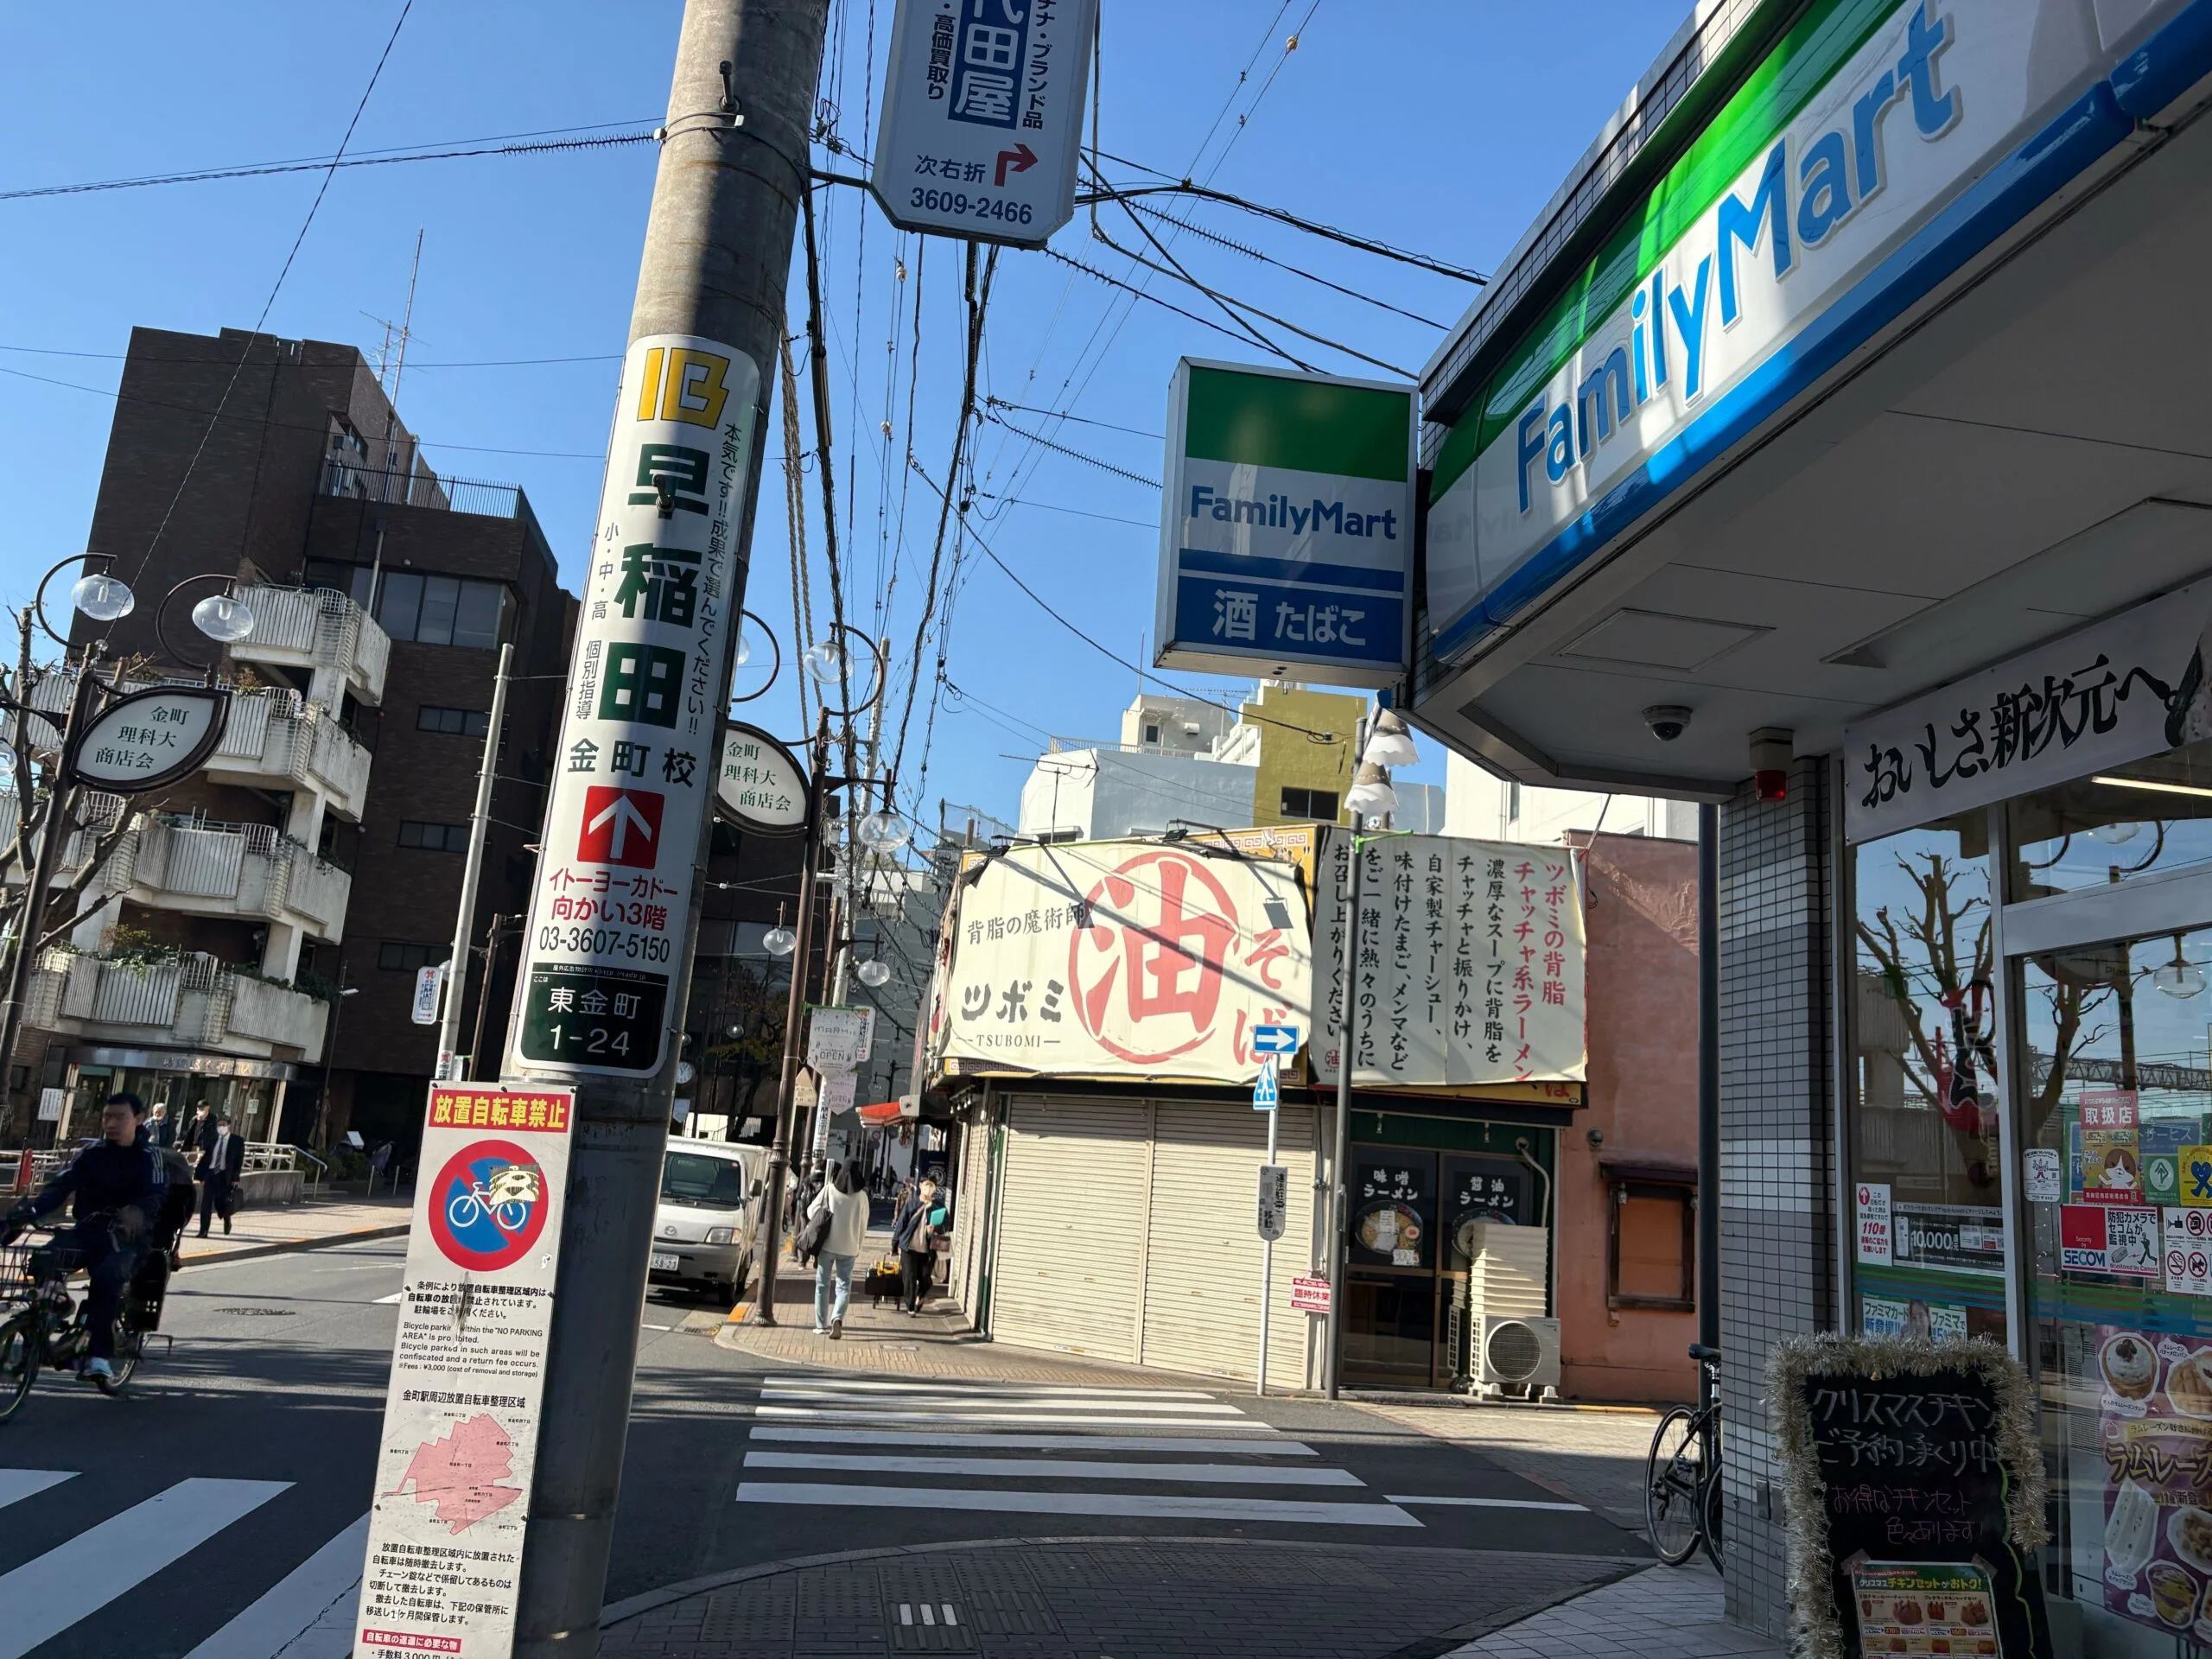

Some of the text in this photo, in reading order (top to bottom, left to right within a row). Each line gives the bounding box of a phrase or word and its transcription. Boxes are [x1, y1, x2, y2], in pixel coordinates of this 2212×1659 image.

[914, 154, 986, 184] 次右折
[910, 187, 1033, 225] 3609-2466
[1517, 0, 1957, 515] FamilyMart
[1191, 485, 1397, 540] FamilyMart
[597, 442, 710, 729] 早稲田
[1211, 588, 1366, 646] 酒 たばこ
[575, 639, 602, 721] 個別指導
[149, 705, 191, 726] 金町
[117, 725, 177, 748] 理科大
[1861, 653, 2171, 809] おいしさ新次元へ
[94, 746, 156, 770] 商店会
[726, 741, 761, 761] 金町
[567, 738, 697, 789] 金町校
[723, 763, 779, 786] 理科大
[740, 789, 791, 812] 商店会
[550, 868, 678, 900] イトーヨーカドー
[551, 895, 668, 931] 向かい3階
[967, 902, 1085, 945] 背脂の魔術師
[539, 926, 671, 963] 03-3607-5150
[1424, 854, 1445, 1036] 自家製チャーシュー、
[1540, 863, 1567, 1007] ツボミの背脂
[1086, 859, 1237, 1038] 油
[1357, 846, 1383, 1068] をご一緒に熱々のうちに
[1453, 855, 1475, 1050] チャッチャと振りかけ、
[1389, 851, 1415, 1071] 味付けたまご、メンマなど
[1484, 858, 1506, 1064] 濃厚なスープに背脂を
[1512, 861, 1536, 1082] チャッチャ系ラーメン
[548, 986, 642, 1020] 東金町
[961, 979, 1065, 1024] ツボミ
[550, 1024, 630, 1057] 1-24
[976, 1033, 1041, 1048] TSUBOMI
[820, 1050, 845, 1061] OPEN
[434, 1094, 566, 1129] 放置自転車禁止
[2084, 1106, 2133, 1125] 取扱店
[1363, 1183, 1419, 1201] ラーメン
[1470, 1176, 1505, 1193] 醤油
[1459, 1191, 1515, 1208] ラーメン
[1862, 1222, 1886, 1236] 110番
[2107, 1211, 2157, 1225] 防犯カメラで
[2108, 1224, 2144, 1236] セコムが
[2108, 1234, 2137, 1247] 監視中
[2063, 1249, 2106, 1268] SECOM
[408, 1293, 537, 1310] 自転車の放置禁止されています。
[404, 1321, 430, 1332] Bicycle
[482, 1325, 494, 1334] the
[510, 1328, 543, 1338] PARKING
[437, 1334, 480, 1344] proibited.
[400, 1342, 429, 1351] Bicycle
[399, 1353, 444, 1362] confiscated
[495, 1357, 508, 1366] fee
[403, 1389, 526, 1409] 金町駅周辺放置自転車整理区域
[1813, 1389, 1998, 1432] クリスマスチキン
[1815, 1427, 1996, 1477] ご予約承り中
[372, 1554, 467, 1573] 自転車は随時撤去します。
[382, 1542, 515, 1563] 放置自転車整理区域内に放置された
[369, 1580, 448, 1597] 切断して撤去します。
[379, 1568, 512, 1589] チェーン錠などで係留してあるものは
[375, 1594, 510, 1616] 撤去した自転車は、下記の保管所に
[366, 1631, 458, 1649] 自転車の返還に必要な物
